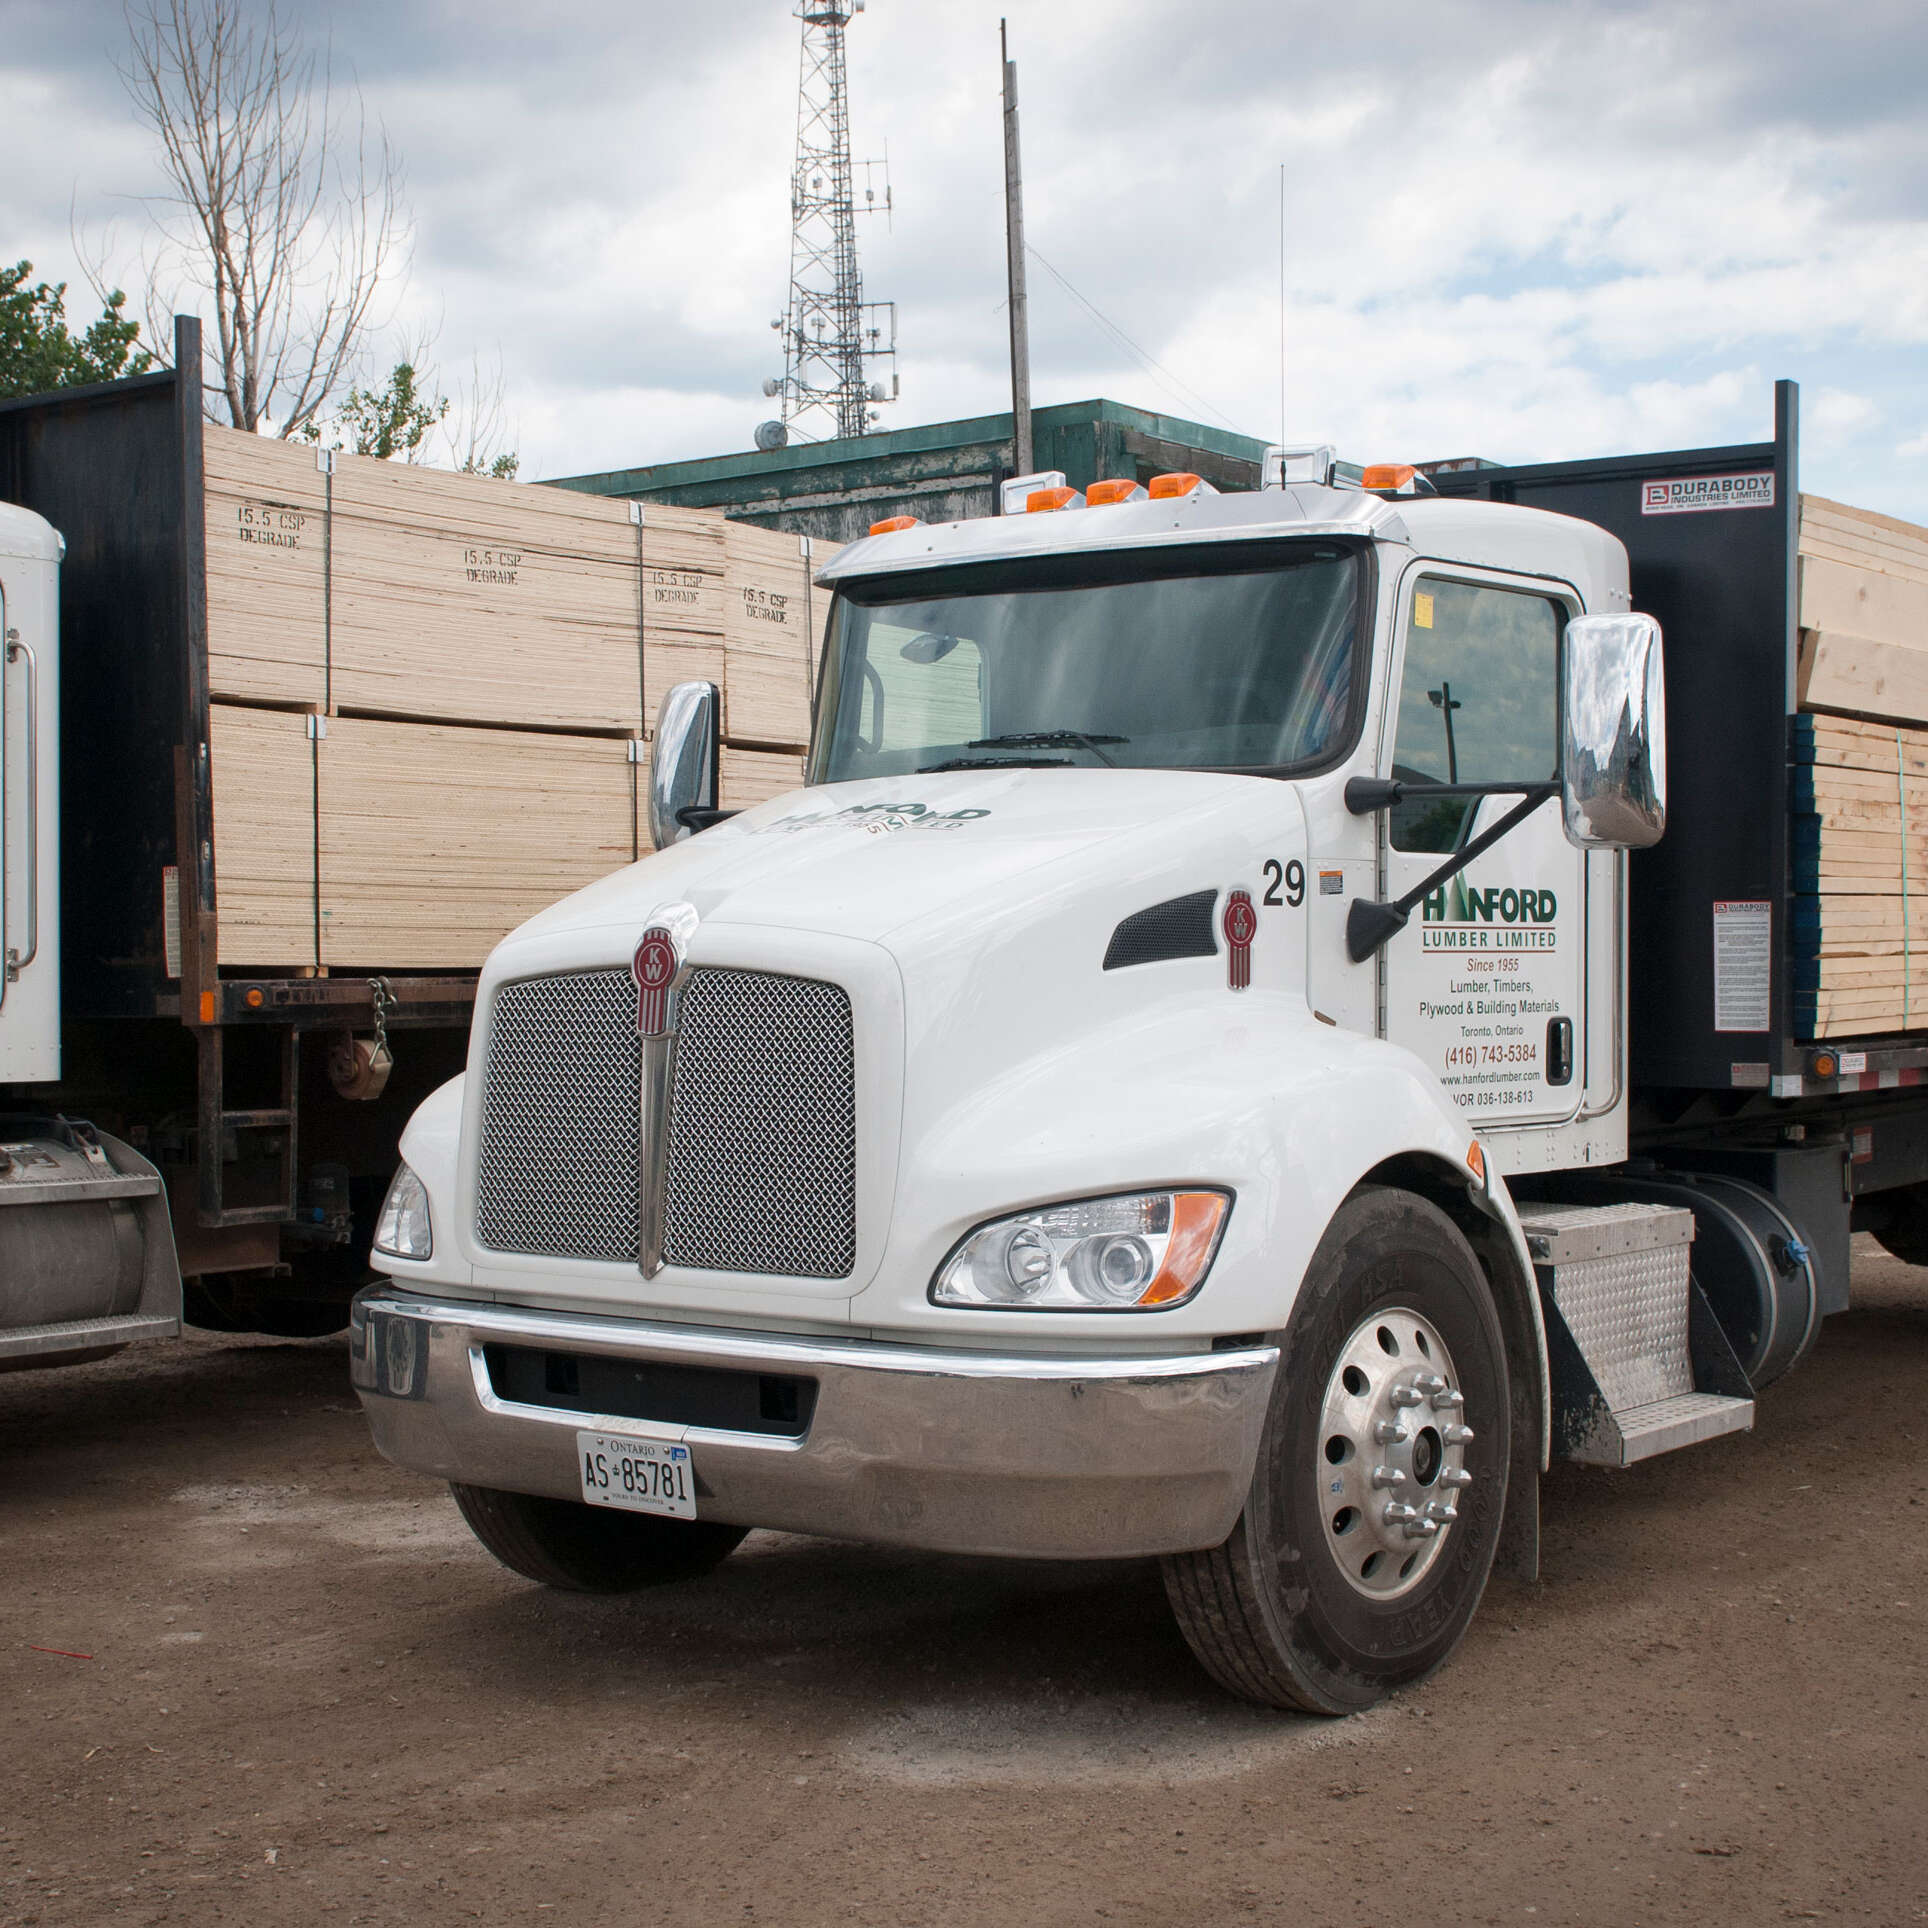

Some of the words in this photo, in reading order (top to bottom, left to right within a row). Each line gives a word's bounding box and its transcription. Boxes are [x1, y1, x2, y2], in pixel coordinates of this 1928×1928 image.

[1671, 477, 1771, 496] DURABODY
[1670, 492, 1729, 504] INDUSTRIES
[1731, 489, 1770, 500] LIMITED
[238, 507, 271, 526] 15.5
[280, 512, 305, 531] CSP
[240, 527, 300, 550] DEGRADE
[499, 552, 521, 568] CSP
[466, 568, 518, 585] DEGRADE
[770, 593, 788, 608] CSP
[745, 603, 788, 625] DEGRADE
[1262, 858, 1306, 908] 29
[1422, 880, 1557, 923] HANFORD
[1422, 931, 1488, 947] LUMBER
[1496, 931, 1556, 947] LIMITED
[1467, 958, 1495, 972] Since
[1498, 958, 1520, 972] 1955
[1450, 979, 1490, 995] Lumber,
[1493, 978, 1534, 994] Timbers,
[1419, 1001, 1464, 1019] Plywood
[1466, 1001, 1474, 1015] &
[1477, 1000, 1517, 1017] Building
[1519, 999, 1560, 1013] Materials
[1460, 1025, 1493, 1038] Toronto,
[1495, 1024, 1524, 1037] Ontario
[1445, 1045, 1477, 1070] (416)
[1481, 1043, 1536, 1064] 743-5384
[1440, 1070, 1540, 1085] www.hanfordlumber.com
[1477, 1090, 1534, 1106] 036-138-613
[610, 1440, 655, 1456] ONTARIO
[586, 1452, 609, 1489] AS
[622, 1457, 688, 1501] 85781
